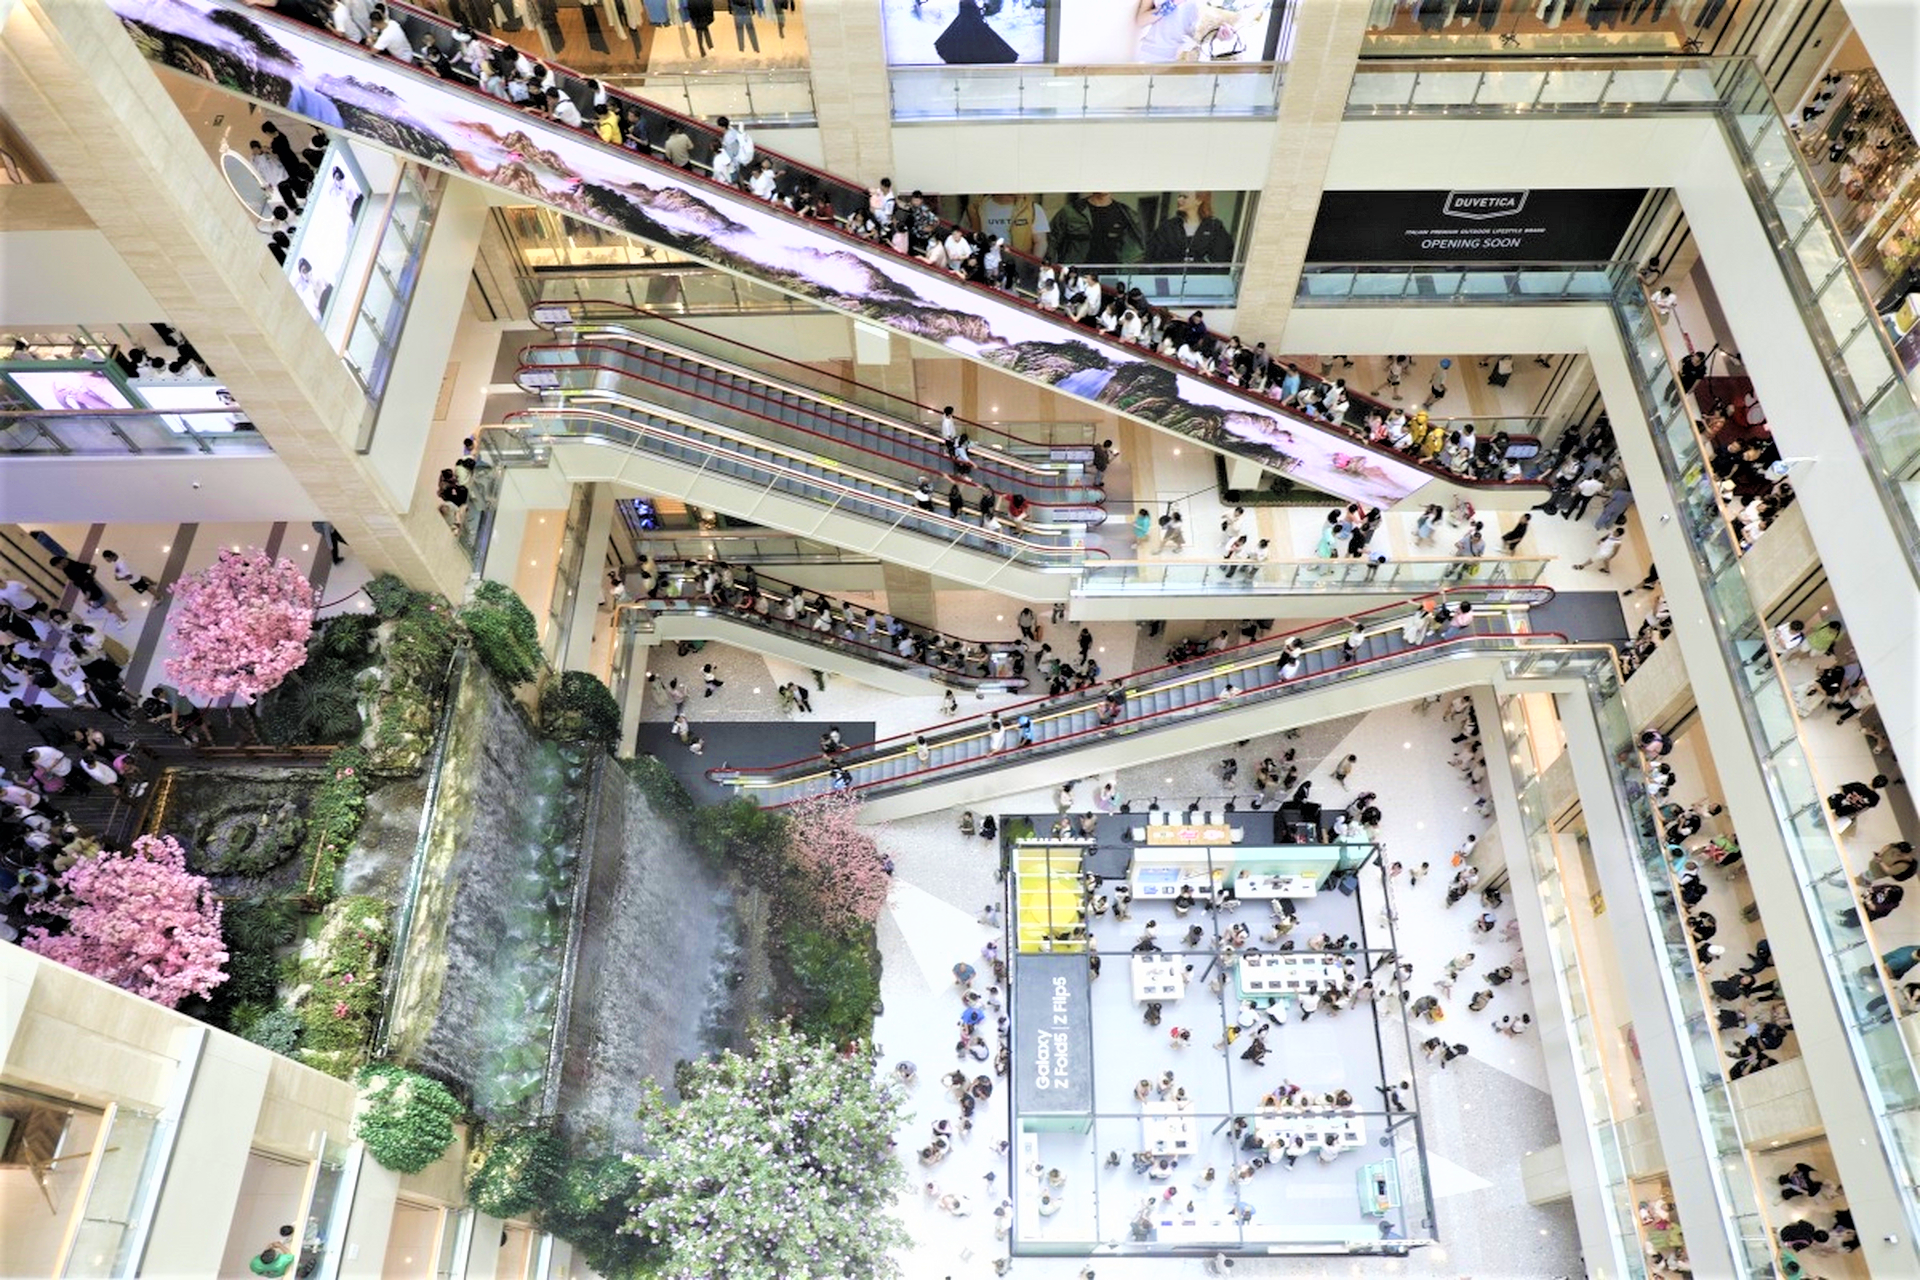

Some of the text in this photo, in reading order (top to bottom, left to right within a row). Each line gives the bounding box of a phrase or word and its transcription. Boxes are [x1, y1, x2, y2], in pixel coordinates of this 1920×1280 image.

[1454, 197, 1515, 208] DUVETICA
[1421, 237, 1521, 249] OPENING SOON
[1053, 977, 1070, 1012] Flip5
[1053, 1014, 1068, 1025] Z
[1036, 1029, 1052, 1089] Galaxy
[1054, 1033, 1068, 1076] Fold5
[1054, 1078, 1069, 1089] Z
